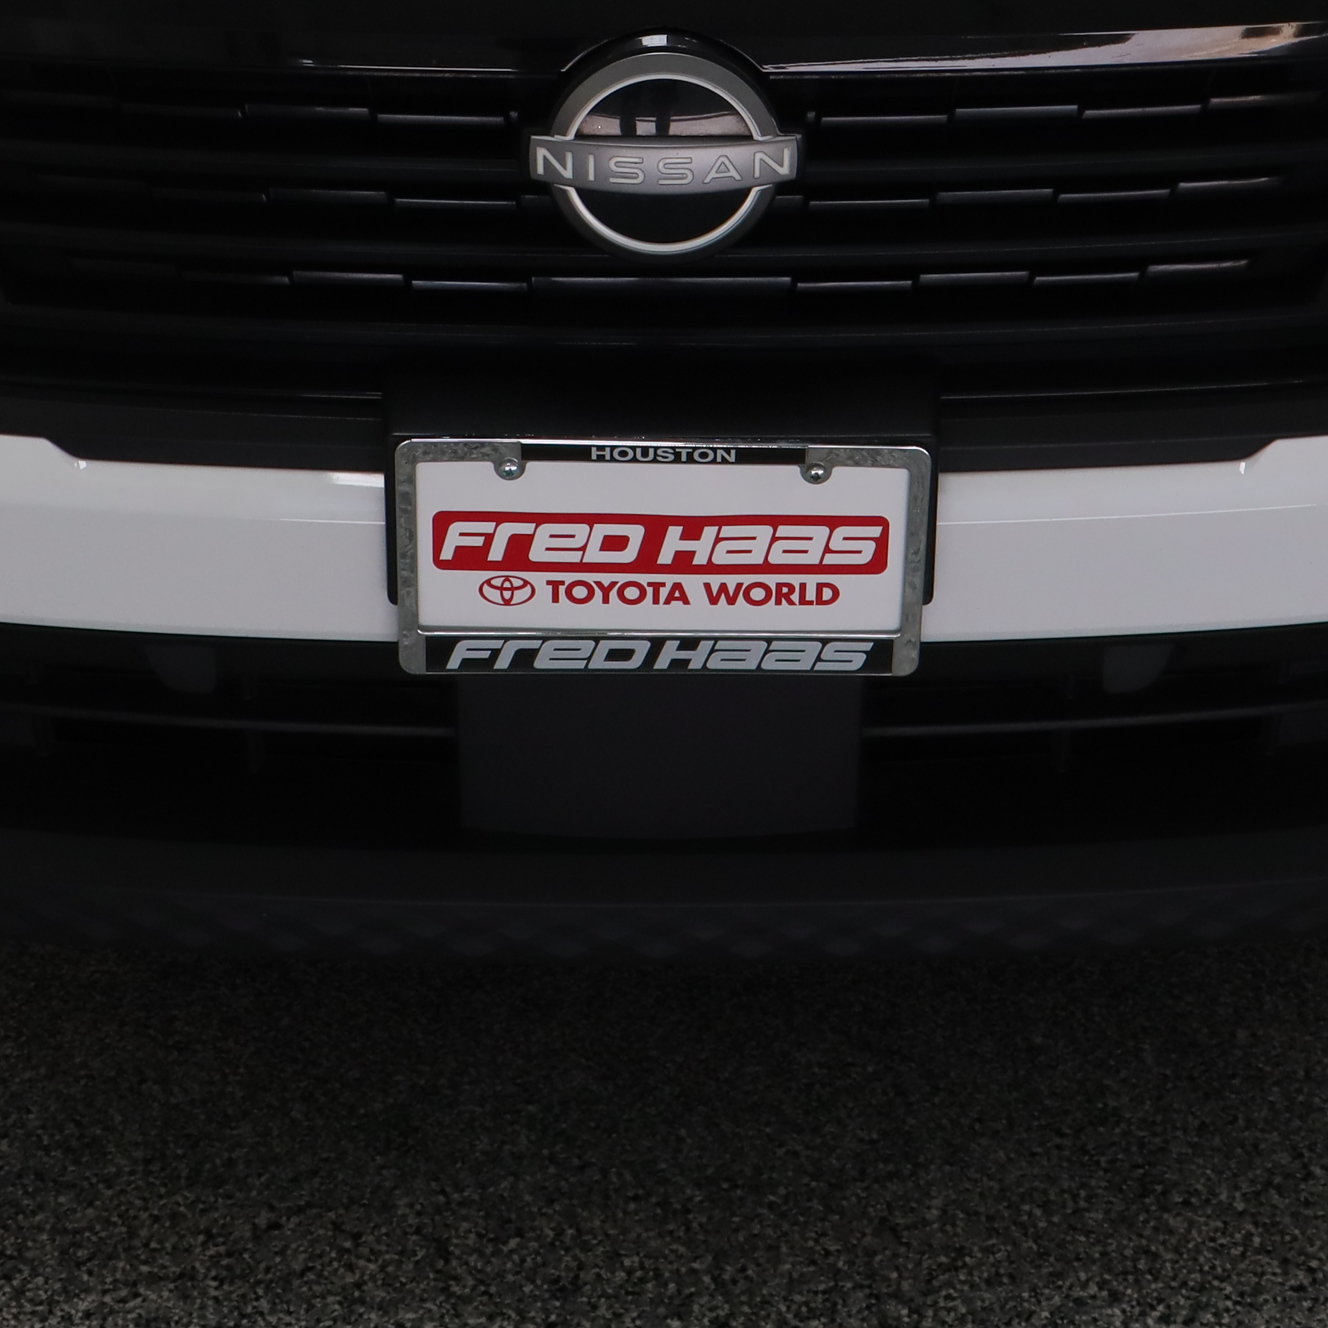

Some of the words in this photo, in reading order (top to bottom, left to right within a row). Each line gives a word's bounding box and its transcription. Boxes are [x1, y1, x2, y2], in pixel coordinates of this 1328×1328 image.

[535, 146, 792, 186] NISSAN
[590, 446, 737, 464] HOUSTON
[545, 579, 691, 606] TOYOTA
[703, 581, 841, 607] WORLD
